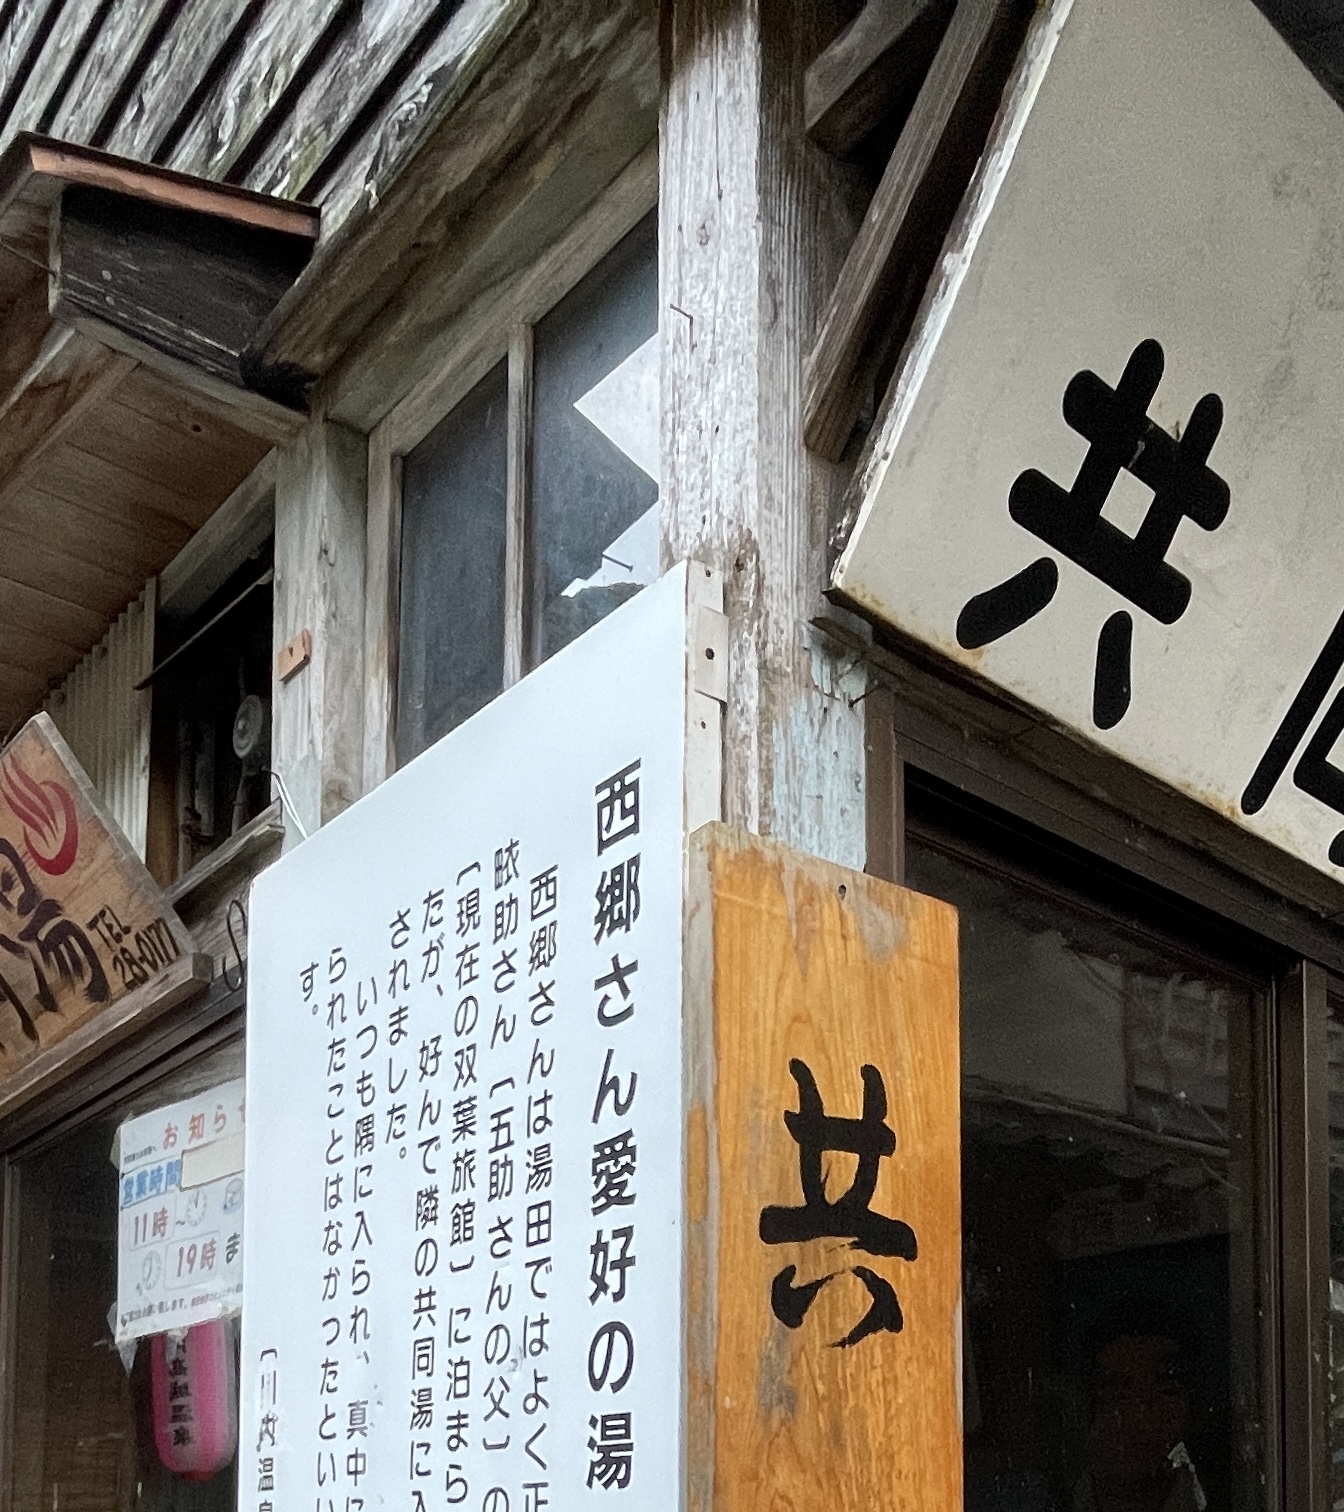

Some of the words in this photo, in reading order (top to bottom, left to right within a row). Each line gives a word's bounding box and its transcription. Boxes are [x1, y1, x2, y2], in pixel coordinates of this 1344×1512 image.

[86, 904, 131, 953] TEL
[299, 961, 320, 1016] す。
[385, 907, 411, 1160] されました。
[585, 757, 642, 1491] 西郷さん愛好の湯
